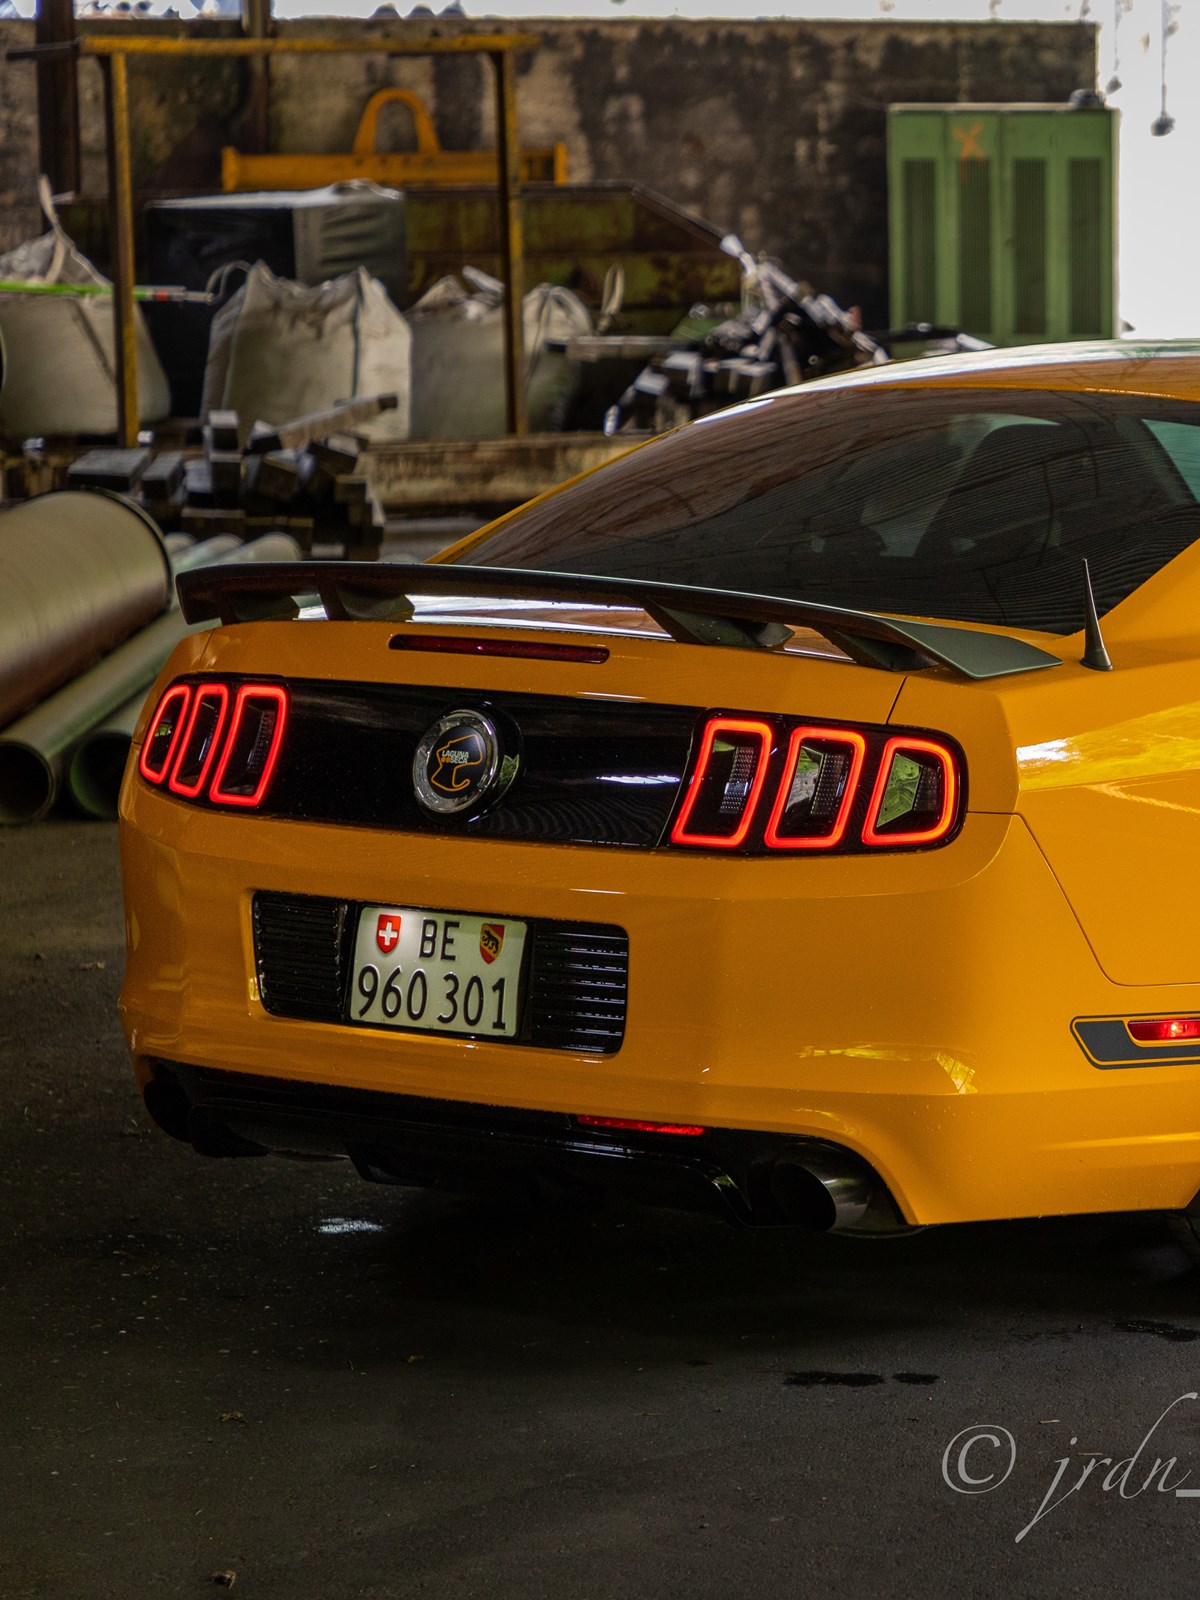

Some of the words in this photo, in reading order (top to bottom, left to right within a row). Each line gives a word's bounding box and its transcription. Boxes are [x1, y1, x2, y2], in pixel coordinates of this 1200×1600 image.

[441, 749, 469, 758] LAGUNA
[450, 755, 468, 764] SECA
[419, 919, 460, 961] BE
[358, 964, 428, 1020] 960
[438, 971, 508, 1031] 301
